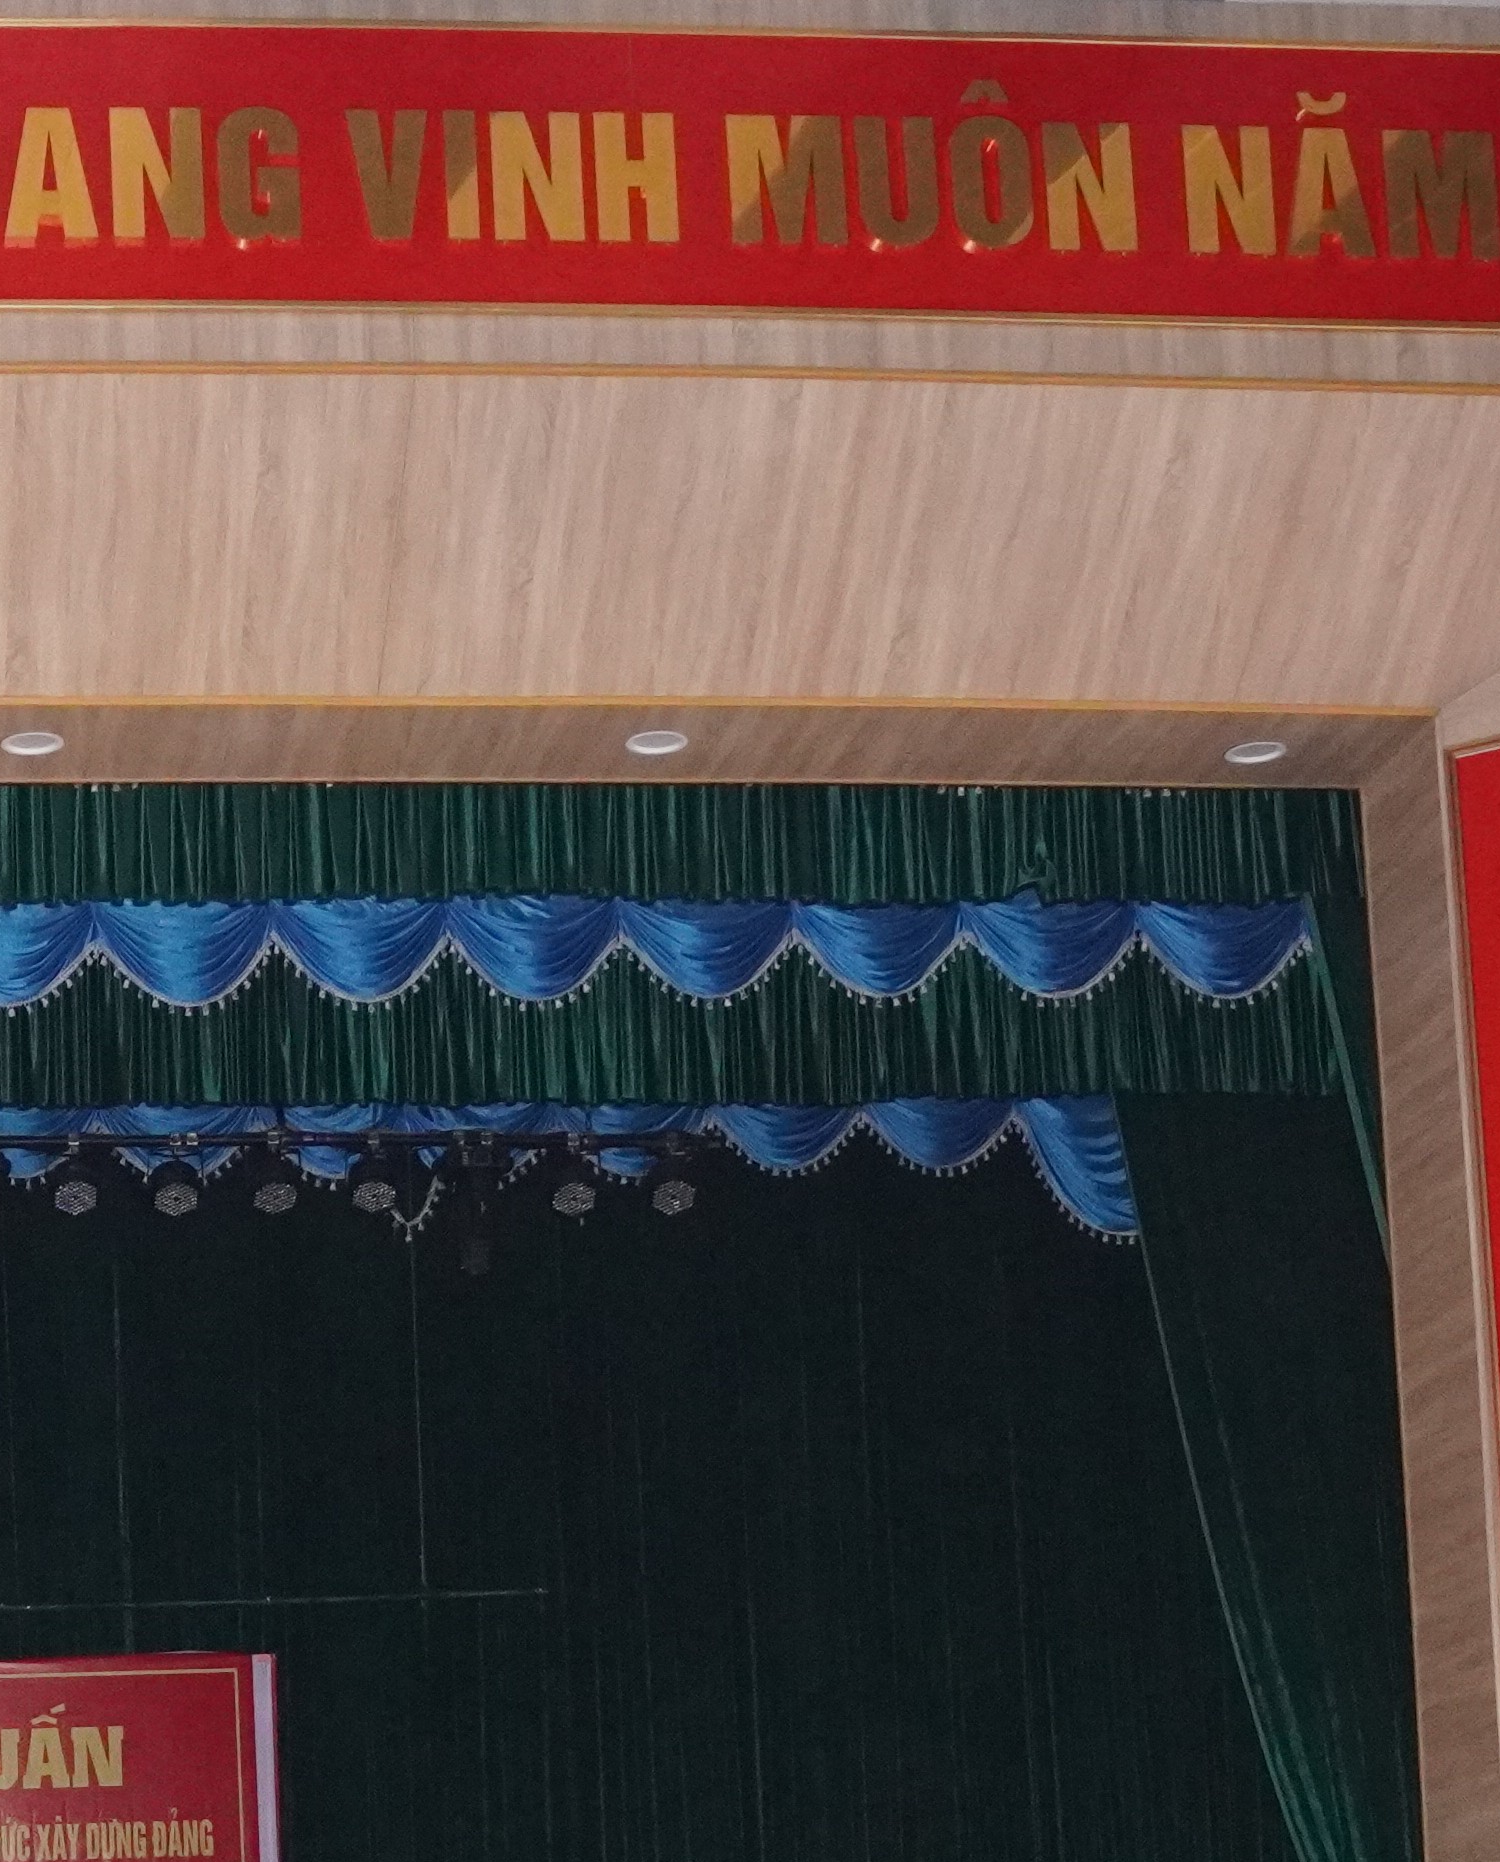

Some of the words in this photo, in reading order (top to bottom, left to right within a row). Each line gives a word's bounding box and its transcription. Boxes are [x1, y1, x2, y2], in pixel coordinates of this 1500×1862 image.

[345, 109, 679, 243] VINH
[725, 80, 1138, 253] MUÔN
[1182, 91, 1500, 260] NĂM
[34, 1815, 80, 1862] XÂY
[152, 1807, 214, 1858] ĐẢNG
